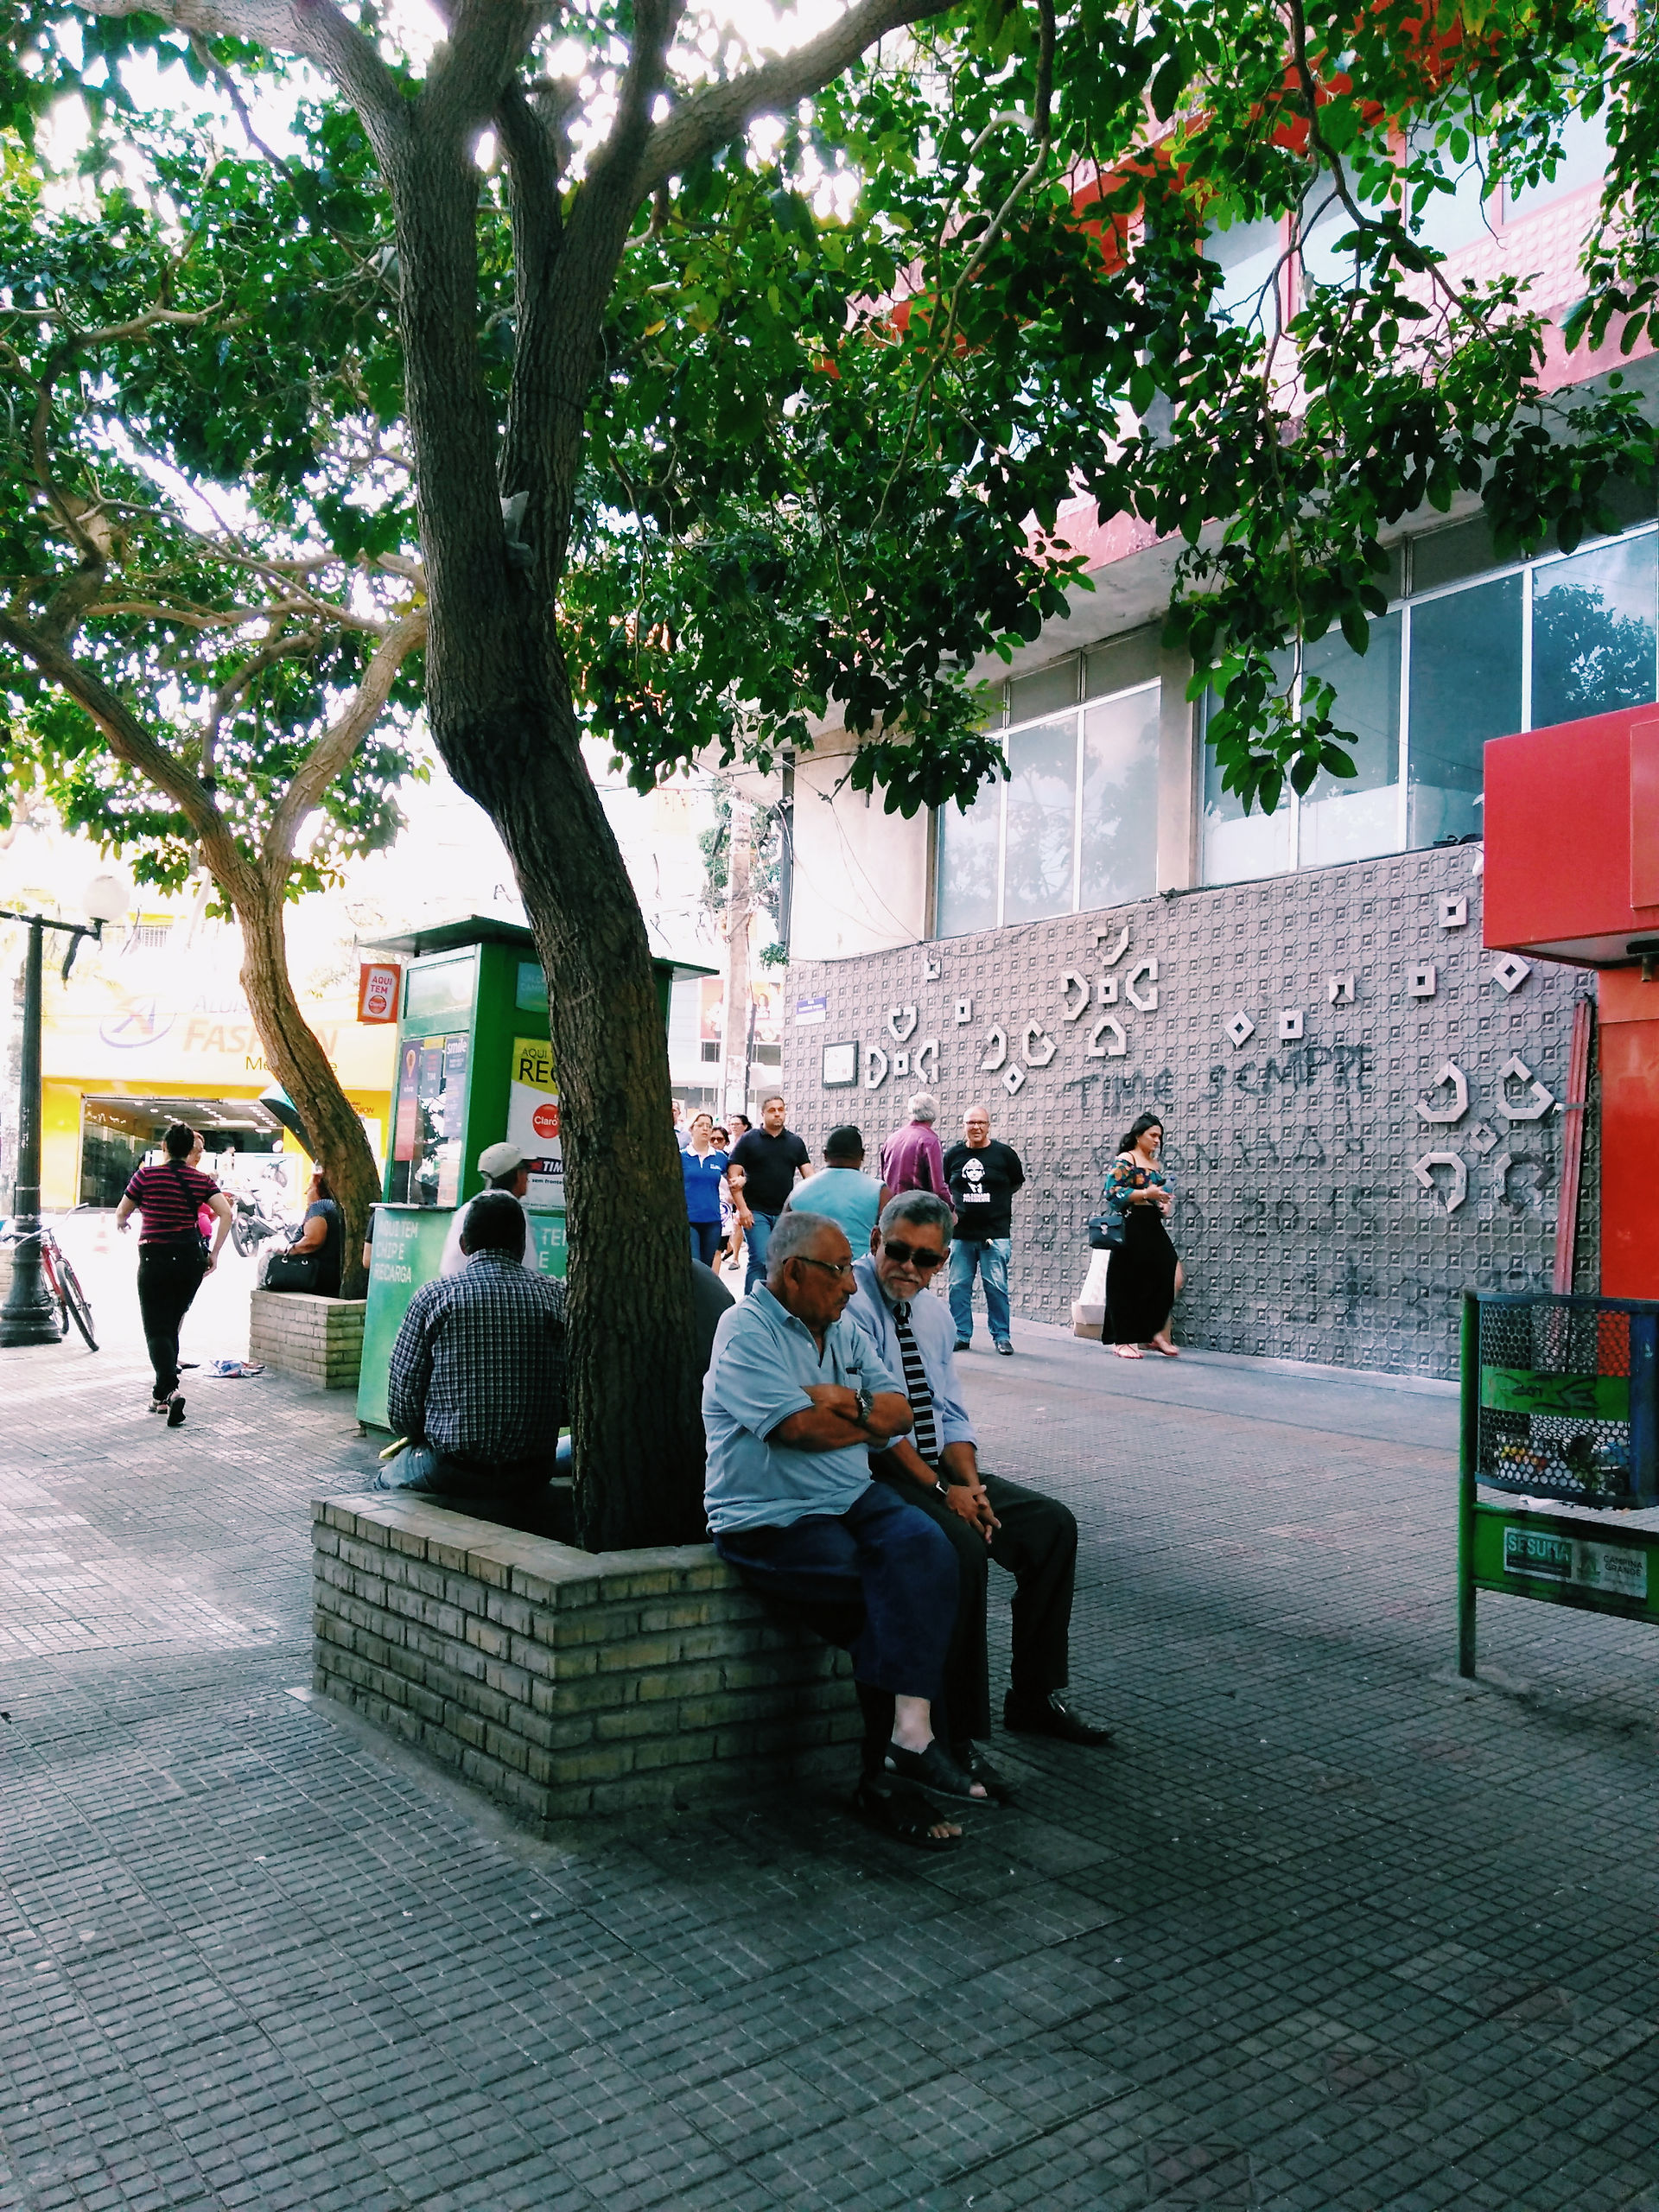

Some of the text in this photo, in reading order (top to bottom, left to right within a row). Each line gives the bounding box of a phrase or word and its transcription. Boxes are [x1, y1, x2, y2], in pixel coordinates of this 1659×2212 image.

[372, 976, 393, 985] AQUI
[370, 985, 388, 994] TEM
[182, 1018, 338, 1057] FASN
[447, 1038, 467, 1054] smile
[522, 1048, 547, 1058] AQUI
[404, 1084, 414, 1093] vivo
[534, 1114, 558, 1126] Claro
[543, 1160, 563, 1173] TIM
[375, 1219, 418, 1238] AQUI TEM
[376, 1242, 404, 1260] CHIP E
[538, 1250, 550, 1268] E
[373, 1263, 412, 1284] RECARGA
[1603, 1555, 1643, 1569] CAMPINA
[1605, 1563, 1642, 1577] GRANDE
